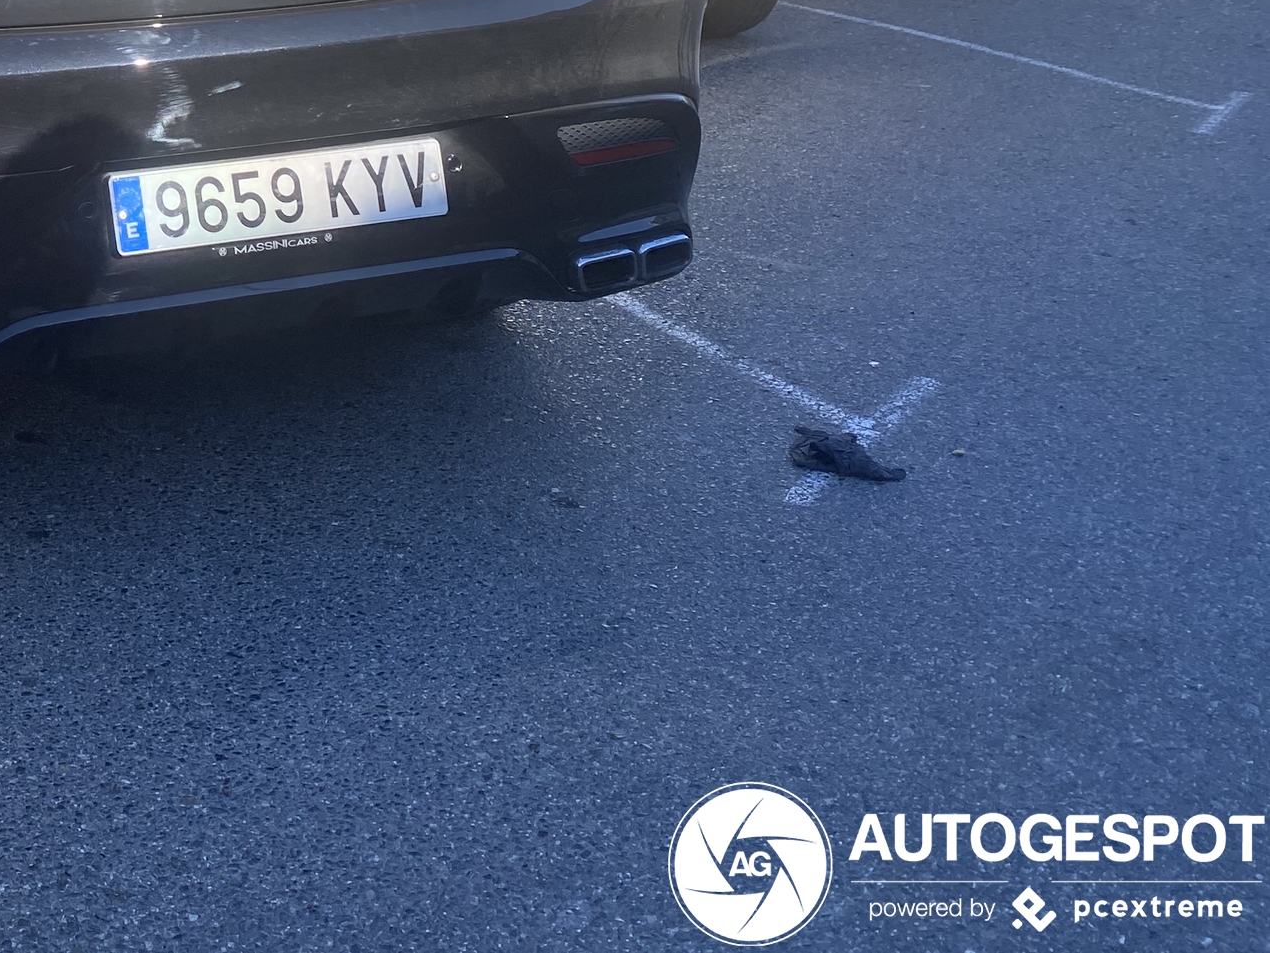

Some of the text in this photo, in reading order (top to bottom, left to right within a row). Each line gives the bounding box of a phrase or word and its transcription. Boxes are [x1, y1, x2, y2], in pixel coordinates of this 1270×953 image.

[155, 151, 426, 239] 9659 KYV
[127, 222, 139, 238] E
